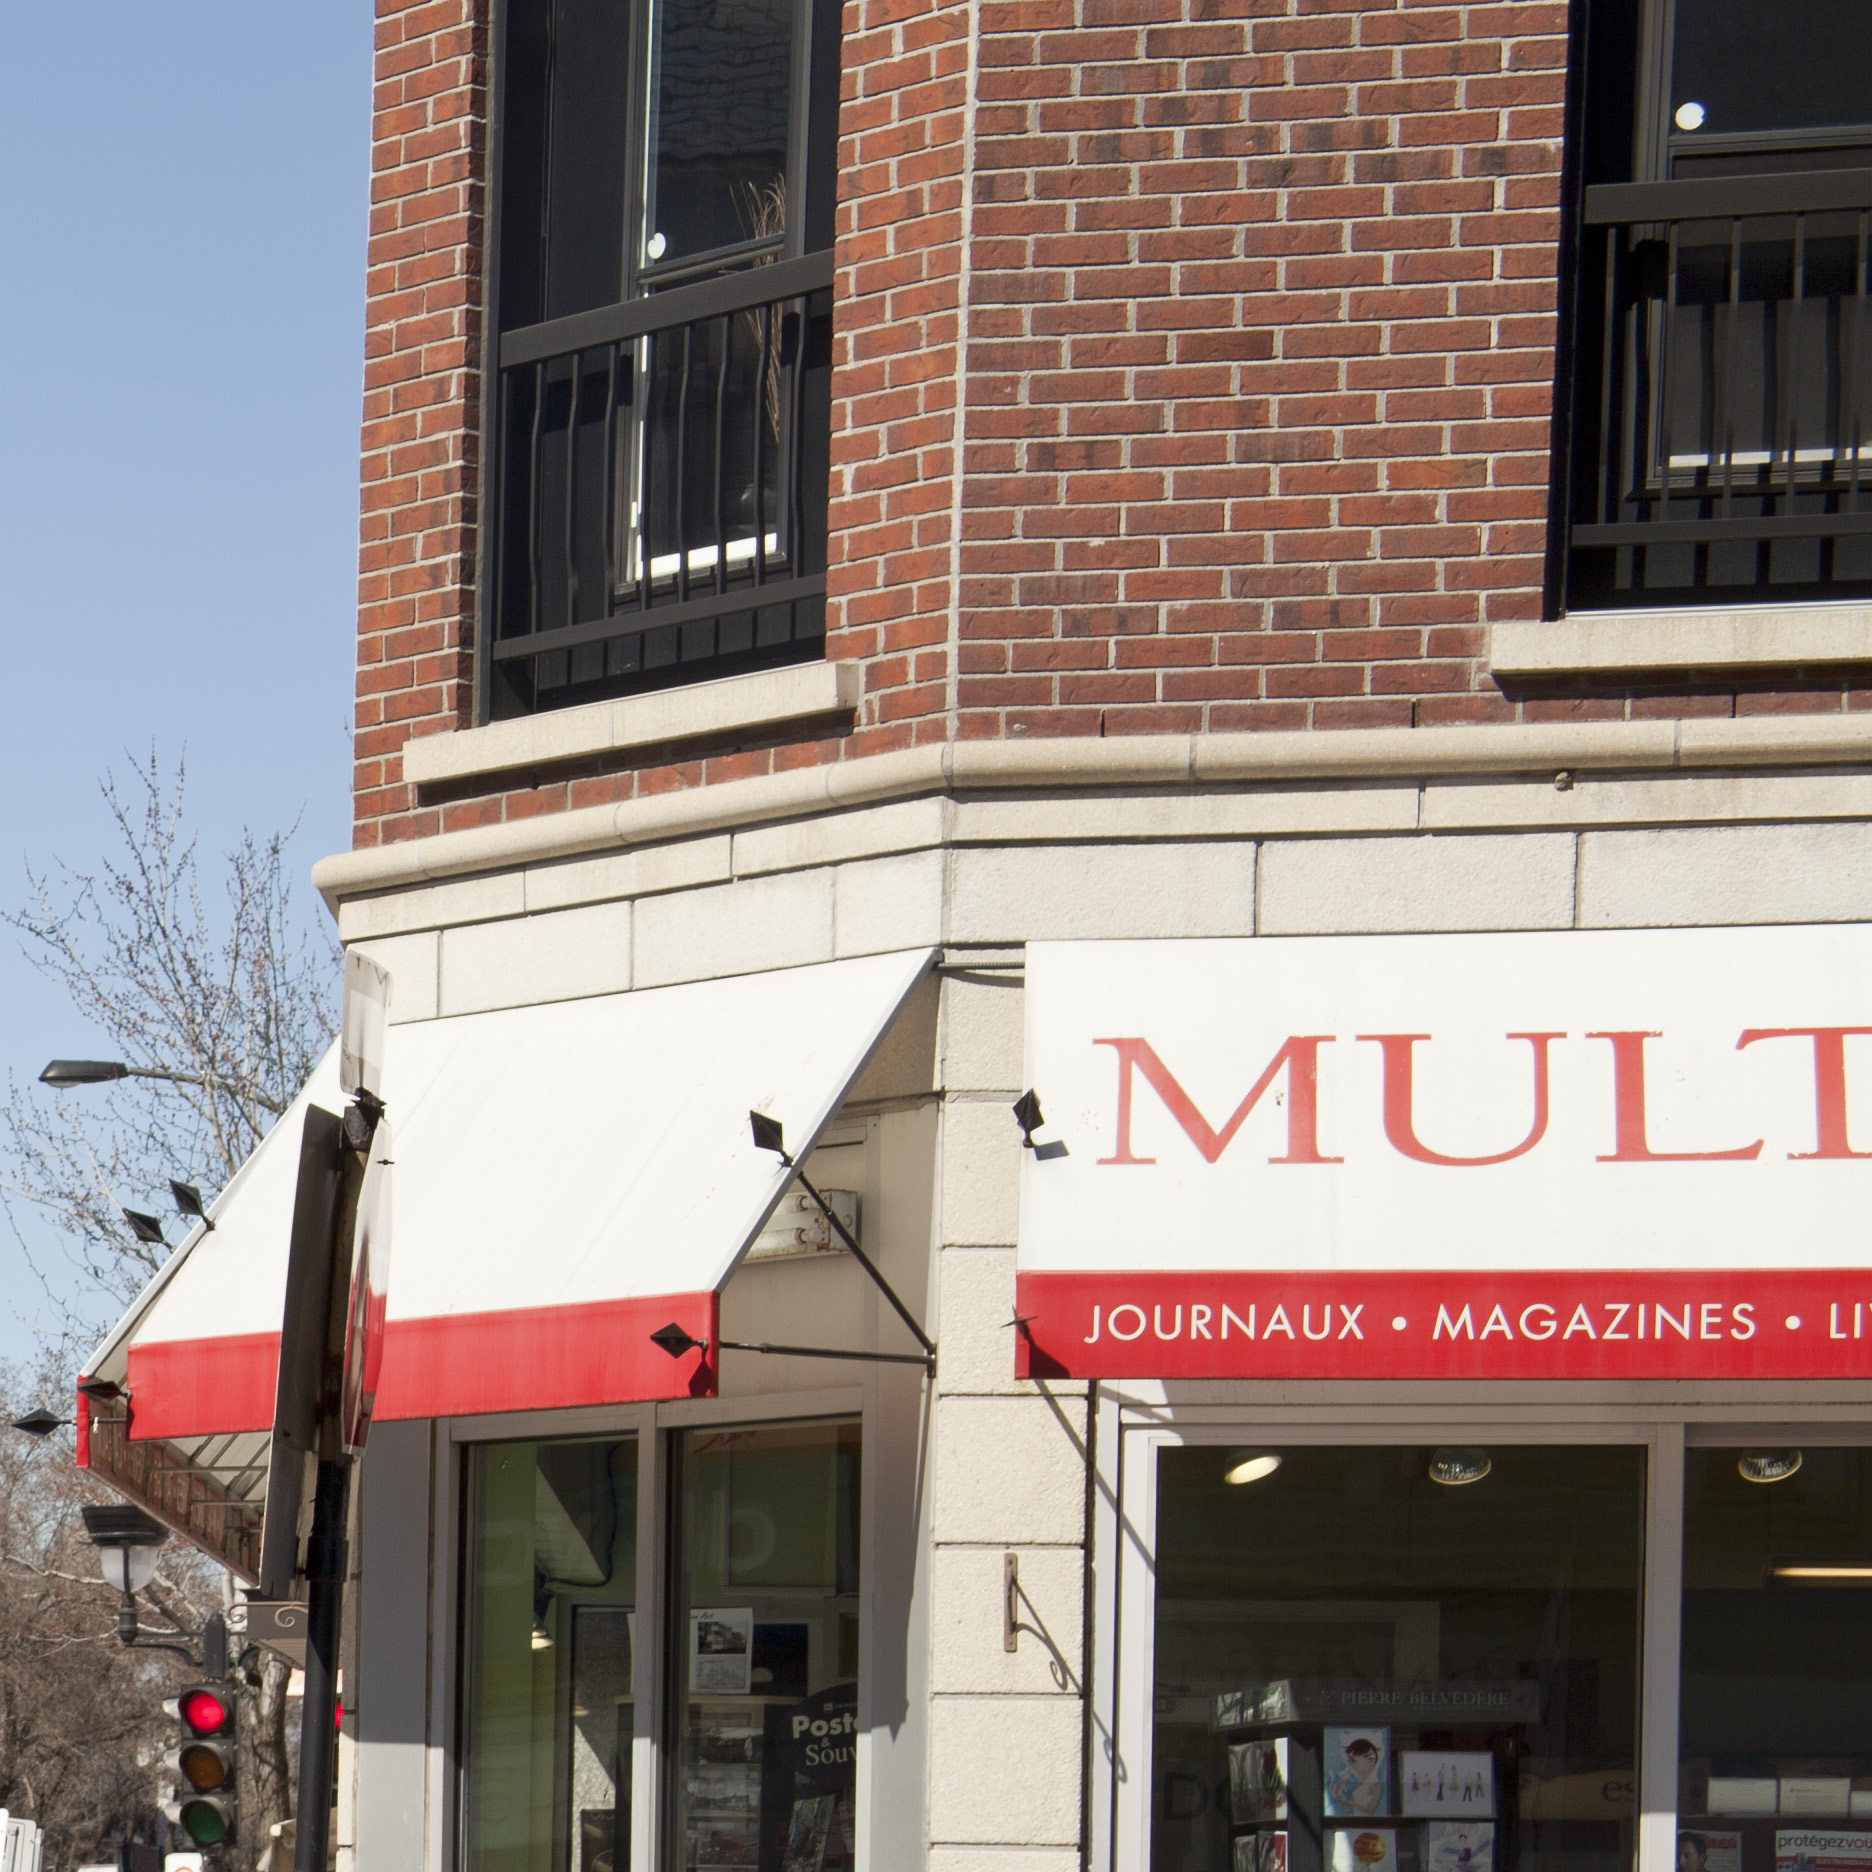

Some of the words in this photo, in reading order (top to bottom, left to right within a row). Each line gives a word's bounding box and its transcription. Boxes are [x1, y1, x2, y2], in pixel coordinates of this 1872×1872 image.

[1085, 1303, 1365, 1344] JOURNAUX
[1432, 1302, 1758, 1343] MAGAZINES
[1341, 1690, 1403, 1706] PIERRE
[792, 1712, 858, 1739] Post
[820, 1737, 831, 1748] &
